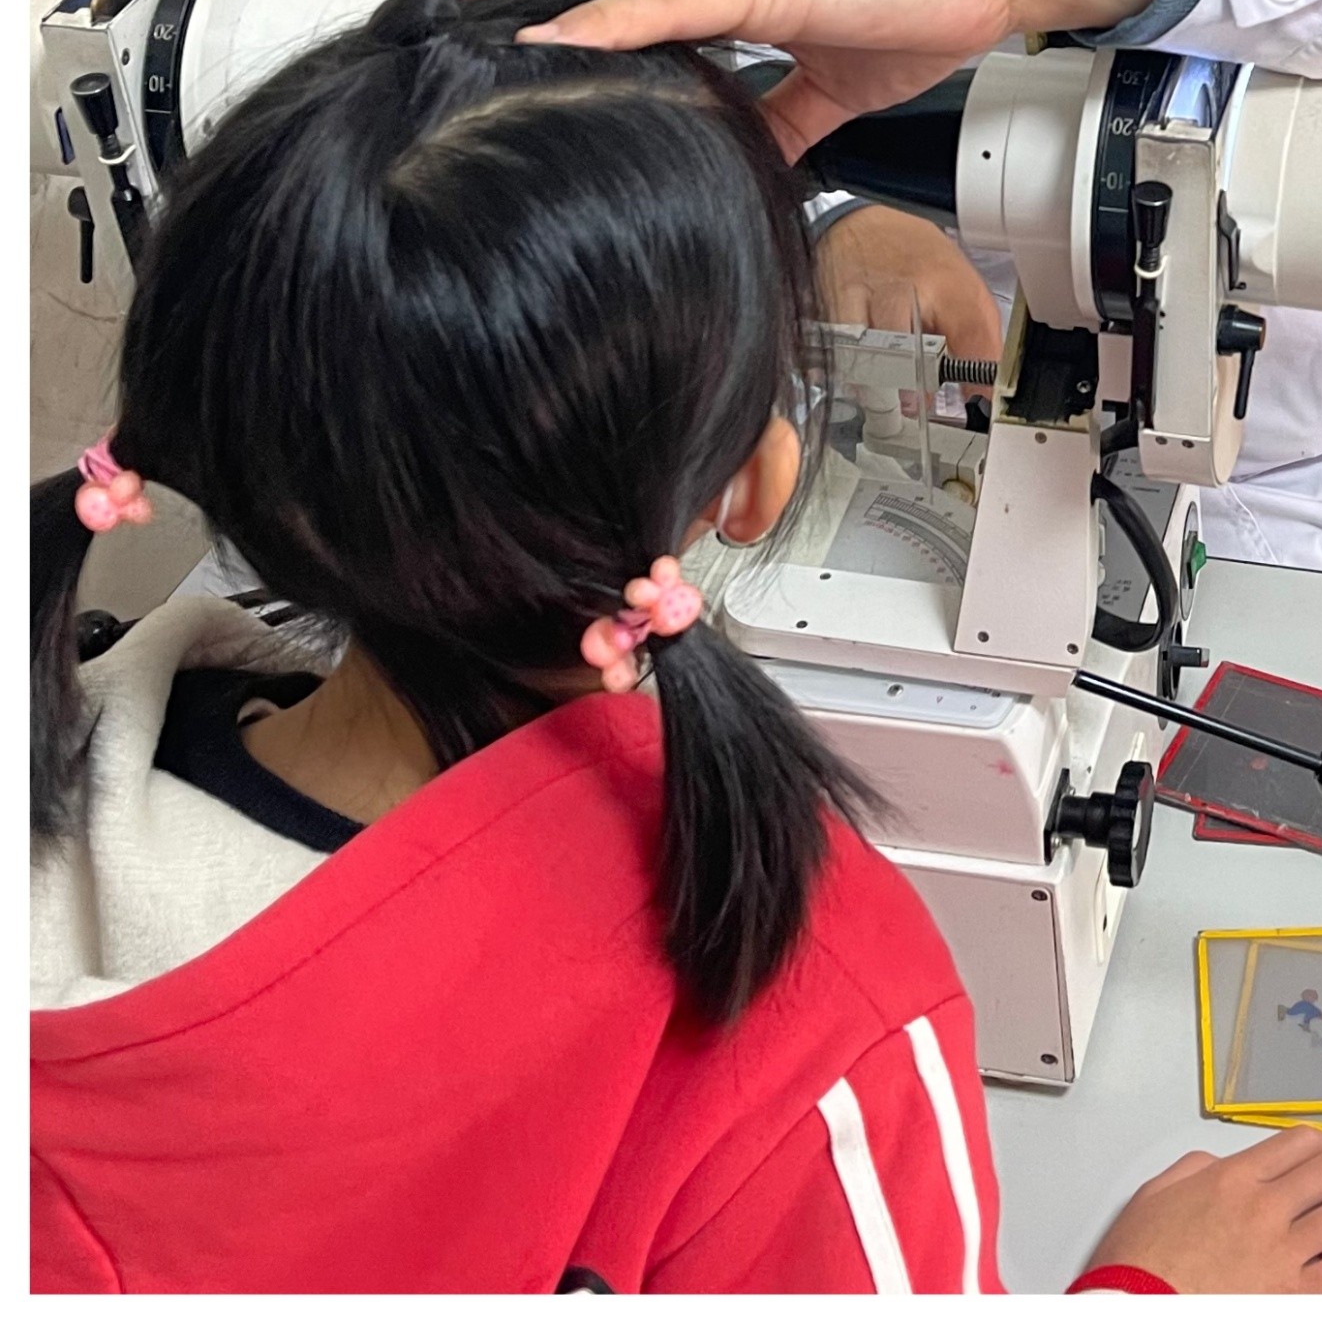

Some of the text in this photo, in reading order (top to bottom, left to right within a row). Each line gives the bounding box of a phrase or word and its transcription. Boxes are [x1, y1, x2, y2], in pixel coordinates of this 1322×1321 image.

[153, 24, 174, 40] 20
[149, 74, 164, 92] 10
[1112, 117, 1134, 136] 20
[1106, 171, 1123, 190] 10
